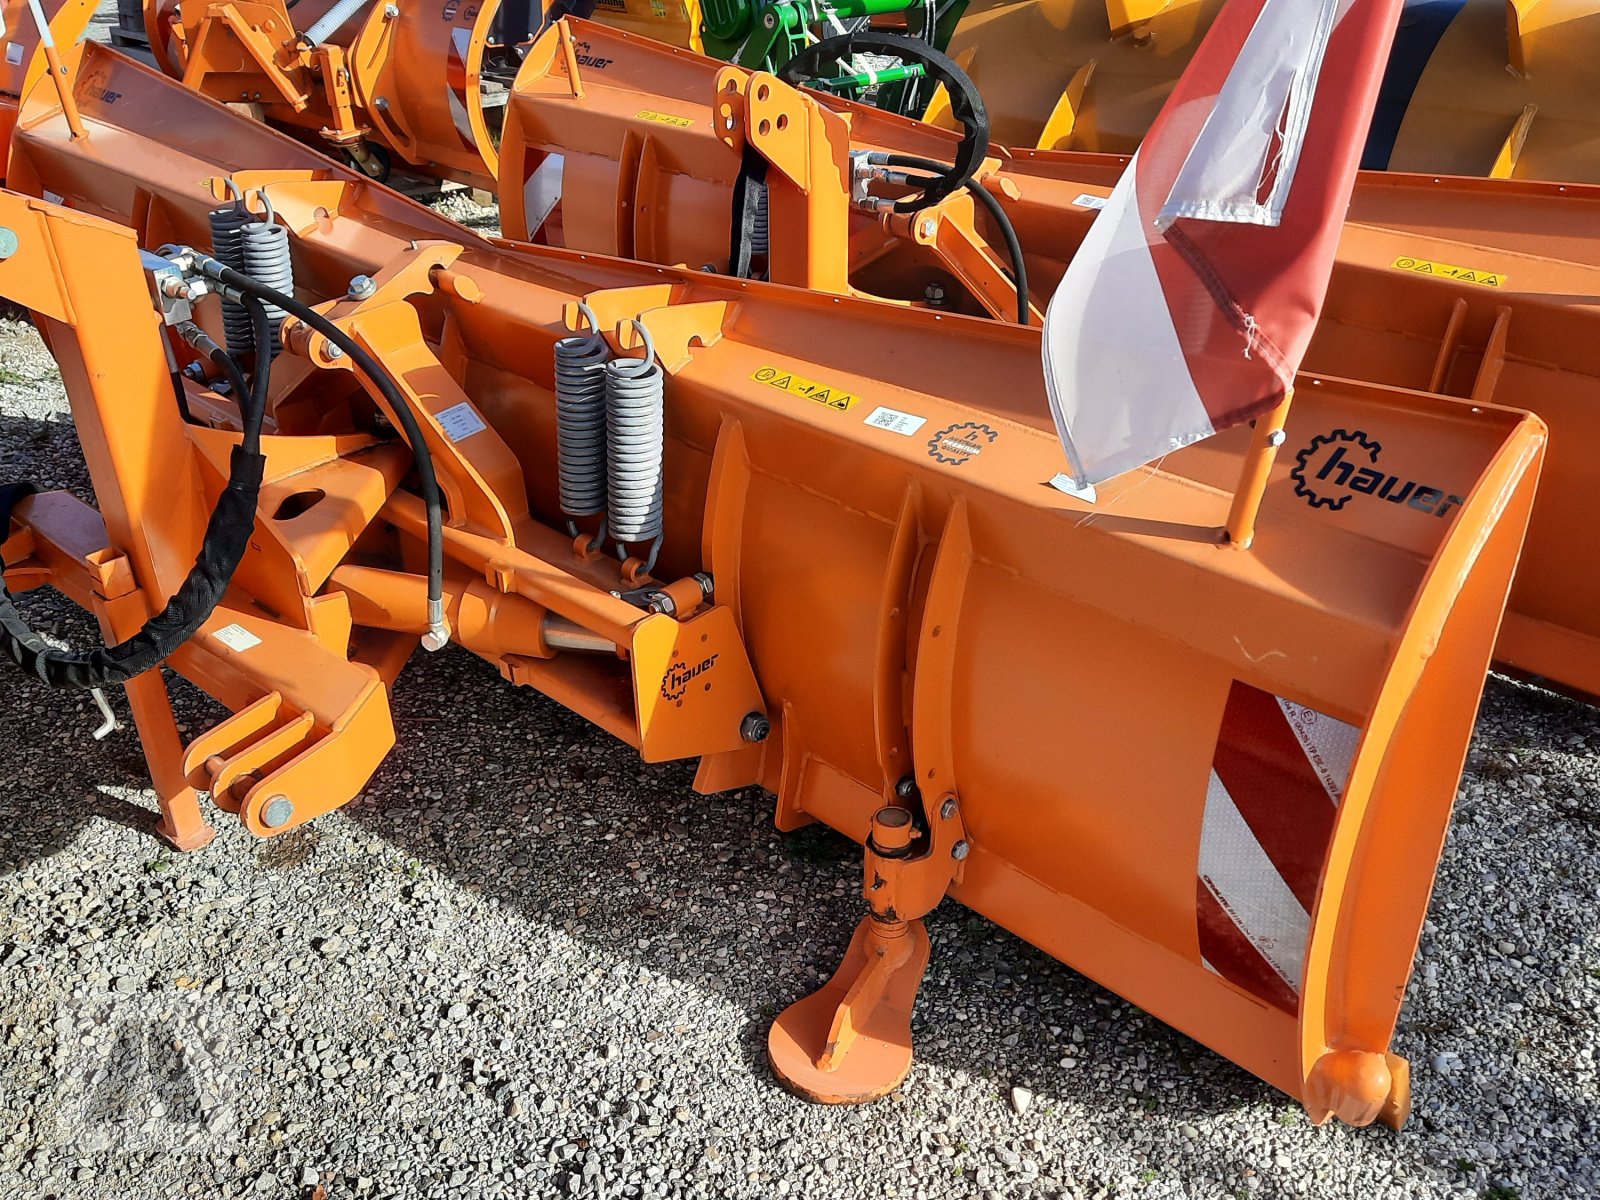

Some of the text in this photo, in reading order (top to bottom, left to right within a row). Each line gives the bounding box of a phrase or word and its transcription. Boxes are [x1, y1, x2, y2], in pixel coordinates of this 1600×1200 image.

[941, 439, 981, 455] PREMIUM
[1316, 446, 1464, 518] hauer
[671, 653, 719, 690] hauer
